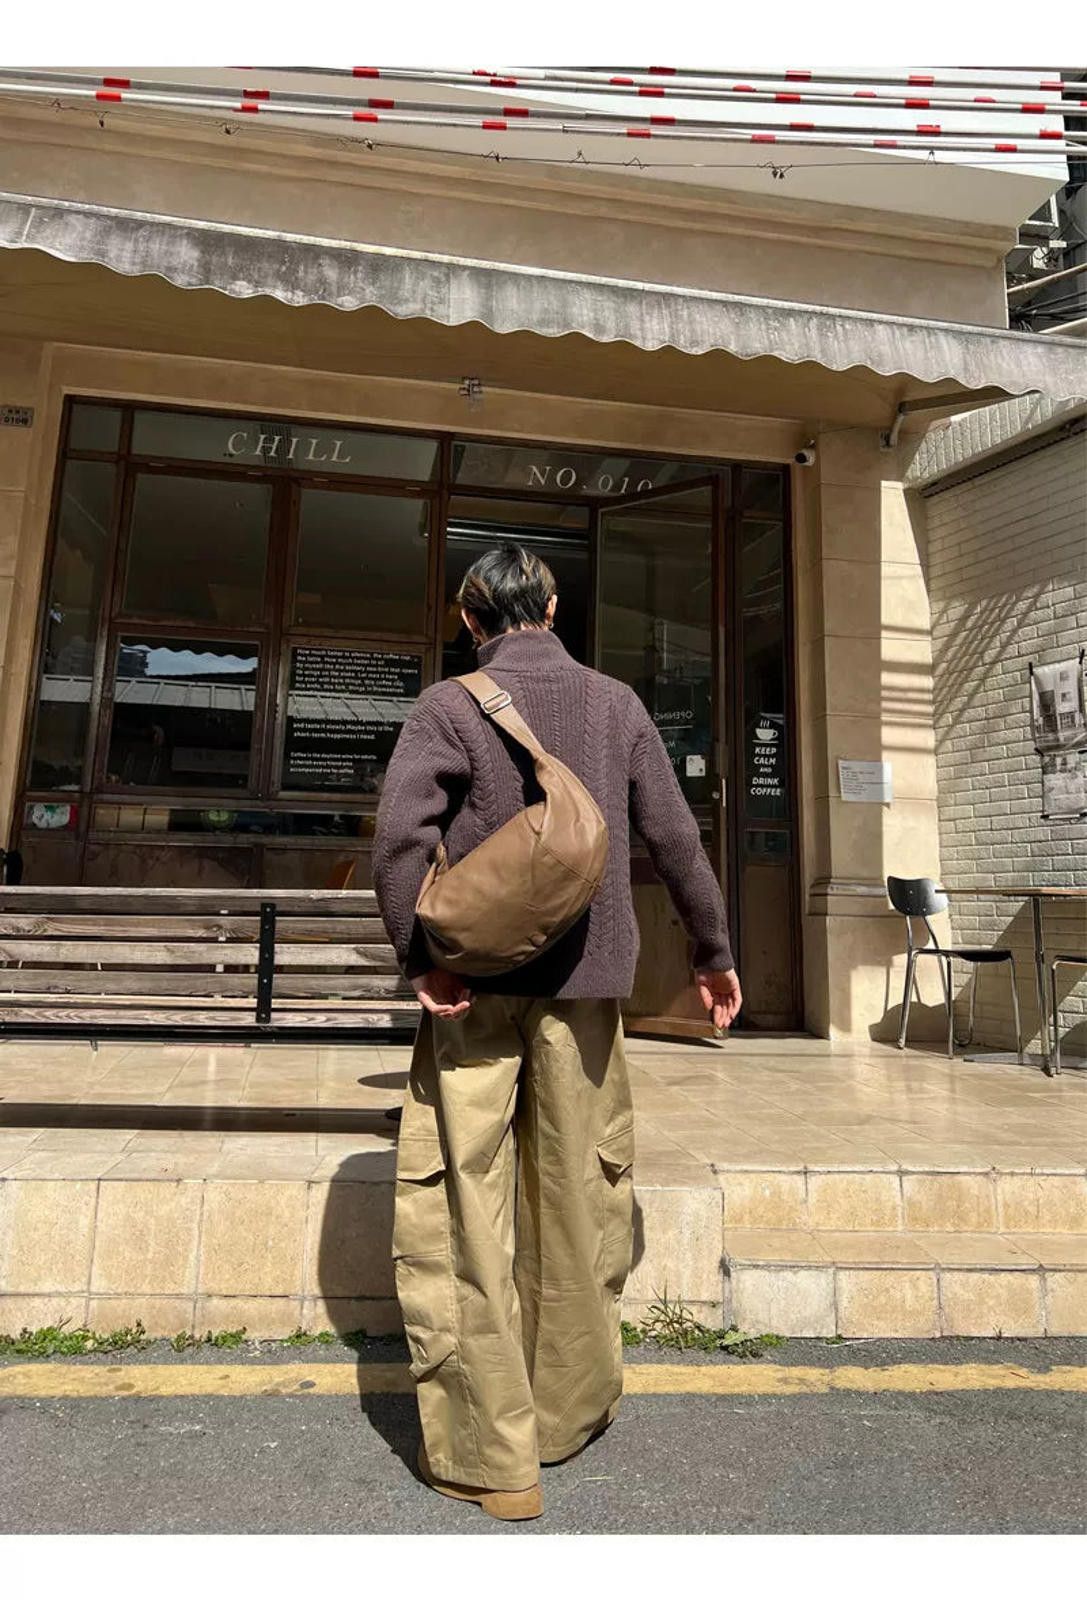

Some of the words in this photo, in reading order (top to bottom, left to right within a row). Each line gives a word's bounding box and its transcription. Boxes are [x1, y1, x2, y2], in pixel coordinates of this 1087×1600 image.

[227, 431, 352, 463] CHILL
[327, 732, 357, 740] happiness
[755, 746, 777, 755] KEEP
[754, 757, 776, 765] CALM
[752, 777, 780, 786] DRINK
[750, 787, 782, 796] COFFEE
